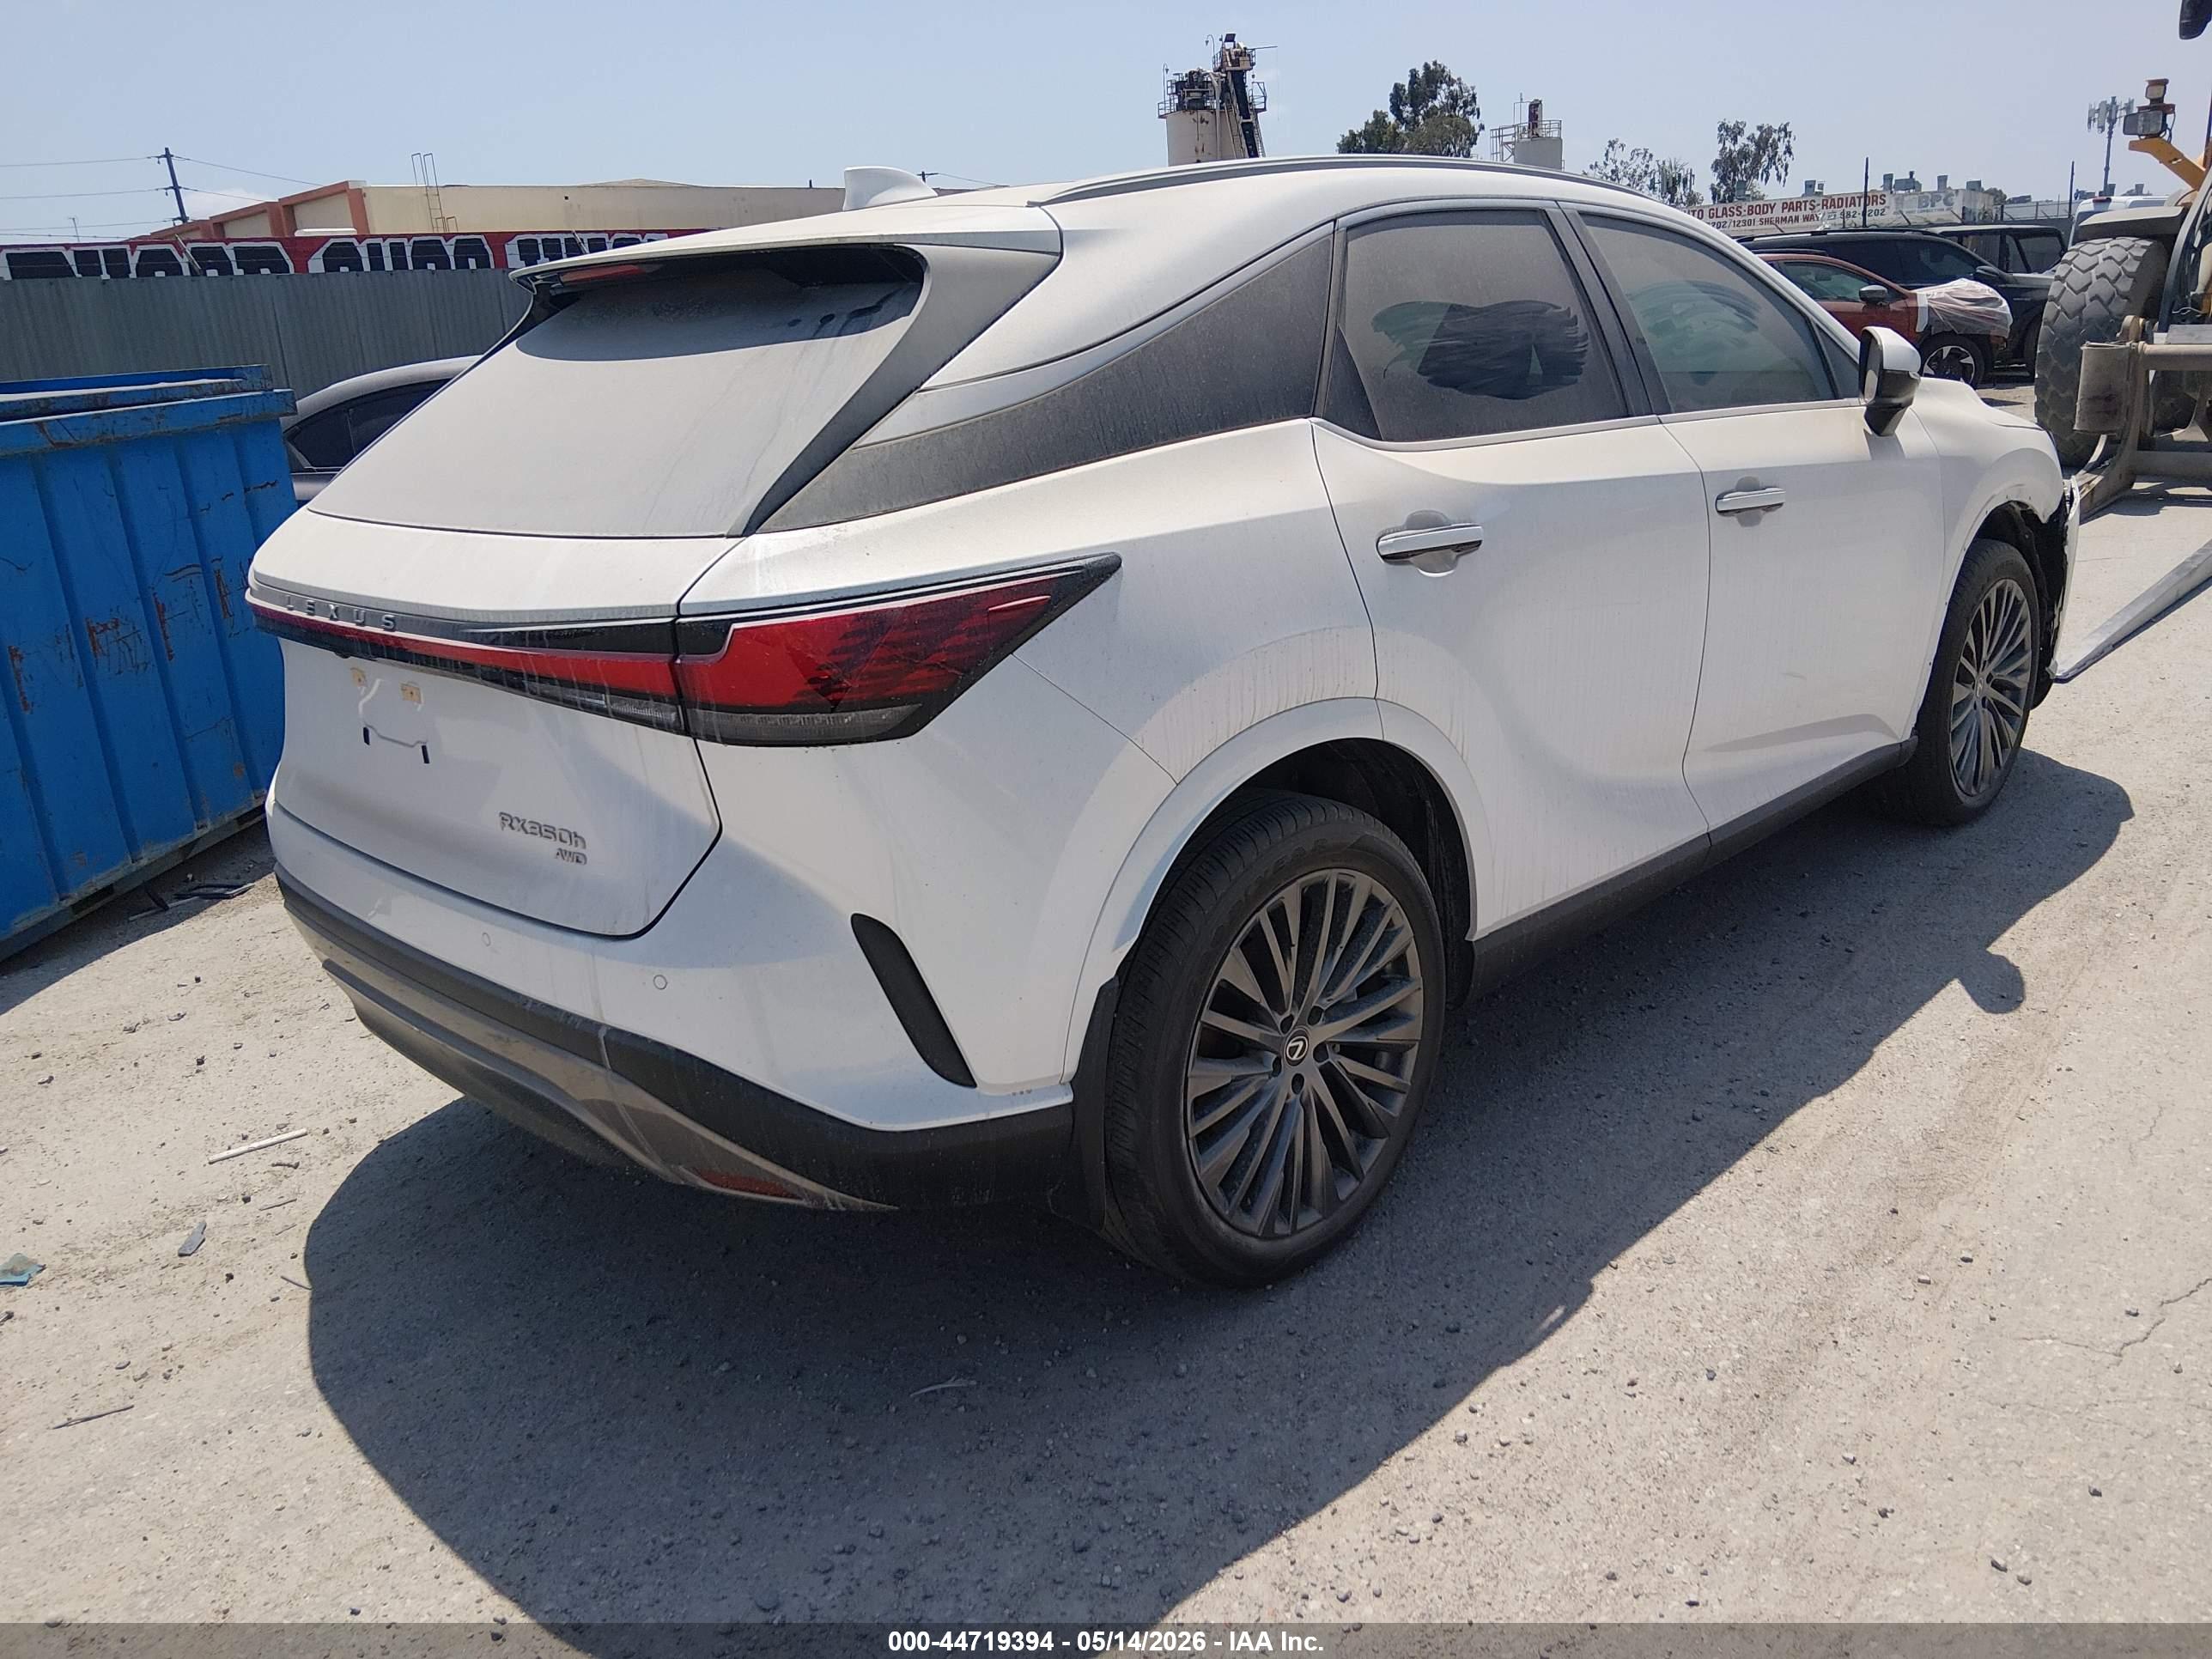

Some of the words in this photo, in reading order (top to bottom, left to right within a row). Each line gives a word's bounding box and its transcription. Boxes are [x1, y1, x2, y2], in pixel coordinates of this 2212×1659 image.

[1759, 215, 1800, 225] SHERMAN
[286, 595, 396, 631] LEXUS
[499, 811, 586, 849] RX350h
[556, 848, 587, 866] AWD
